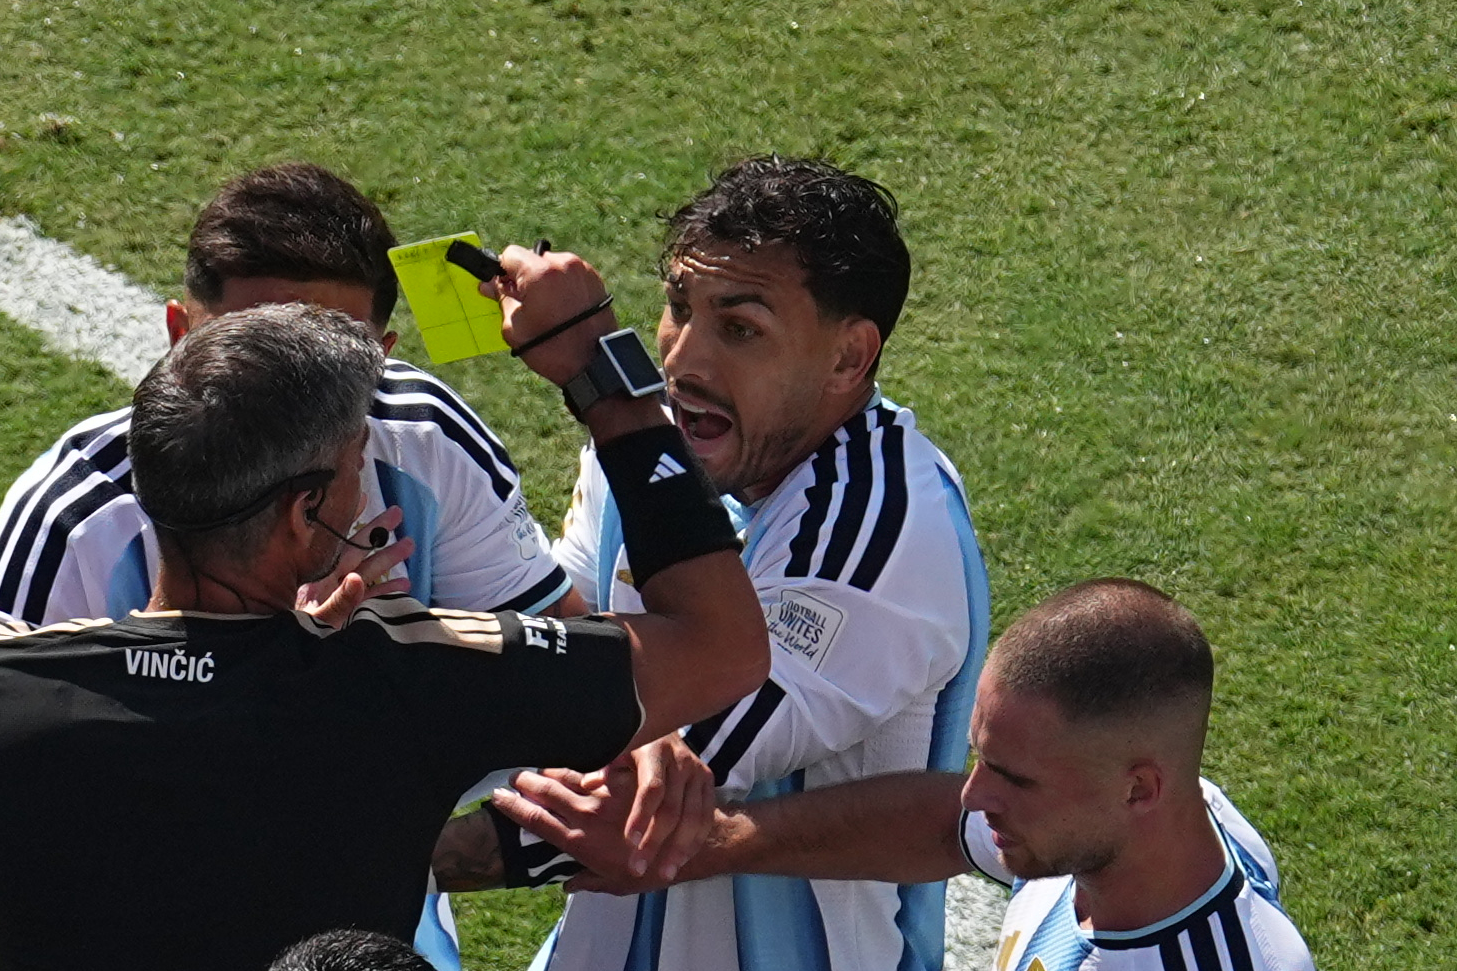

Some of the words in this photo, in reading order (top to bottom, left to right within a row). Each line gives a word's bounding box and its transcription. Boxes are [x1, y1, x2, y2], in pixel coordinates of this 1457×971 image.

[767, 621, 784, 639] the
[783, 631, 820, 660] World
[779, 603, 824, 644] UNITES
[124, 646, 216, 684] VINČIĆ
